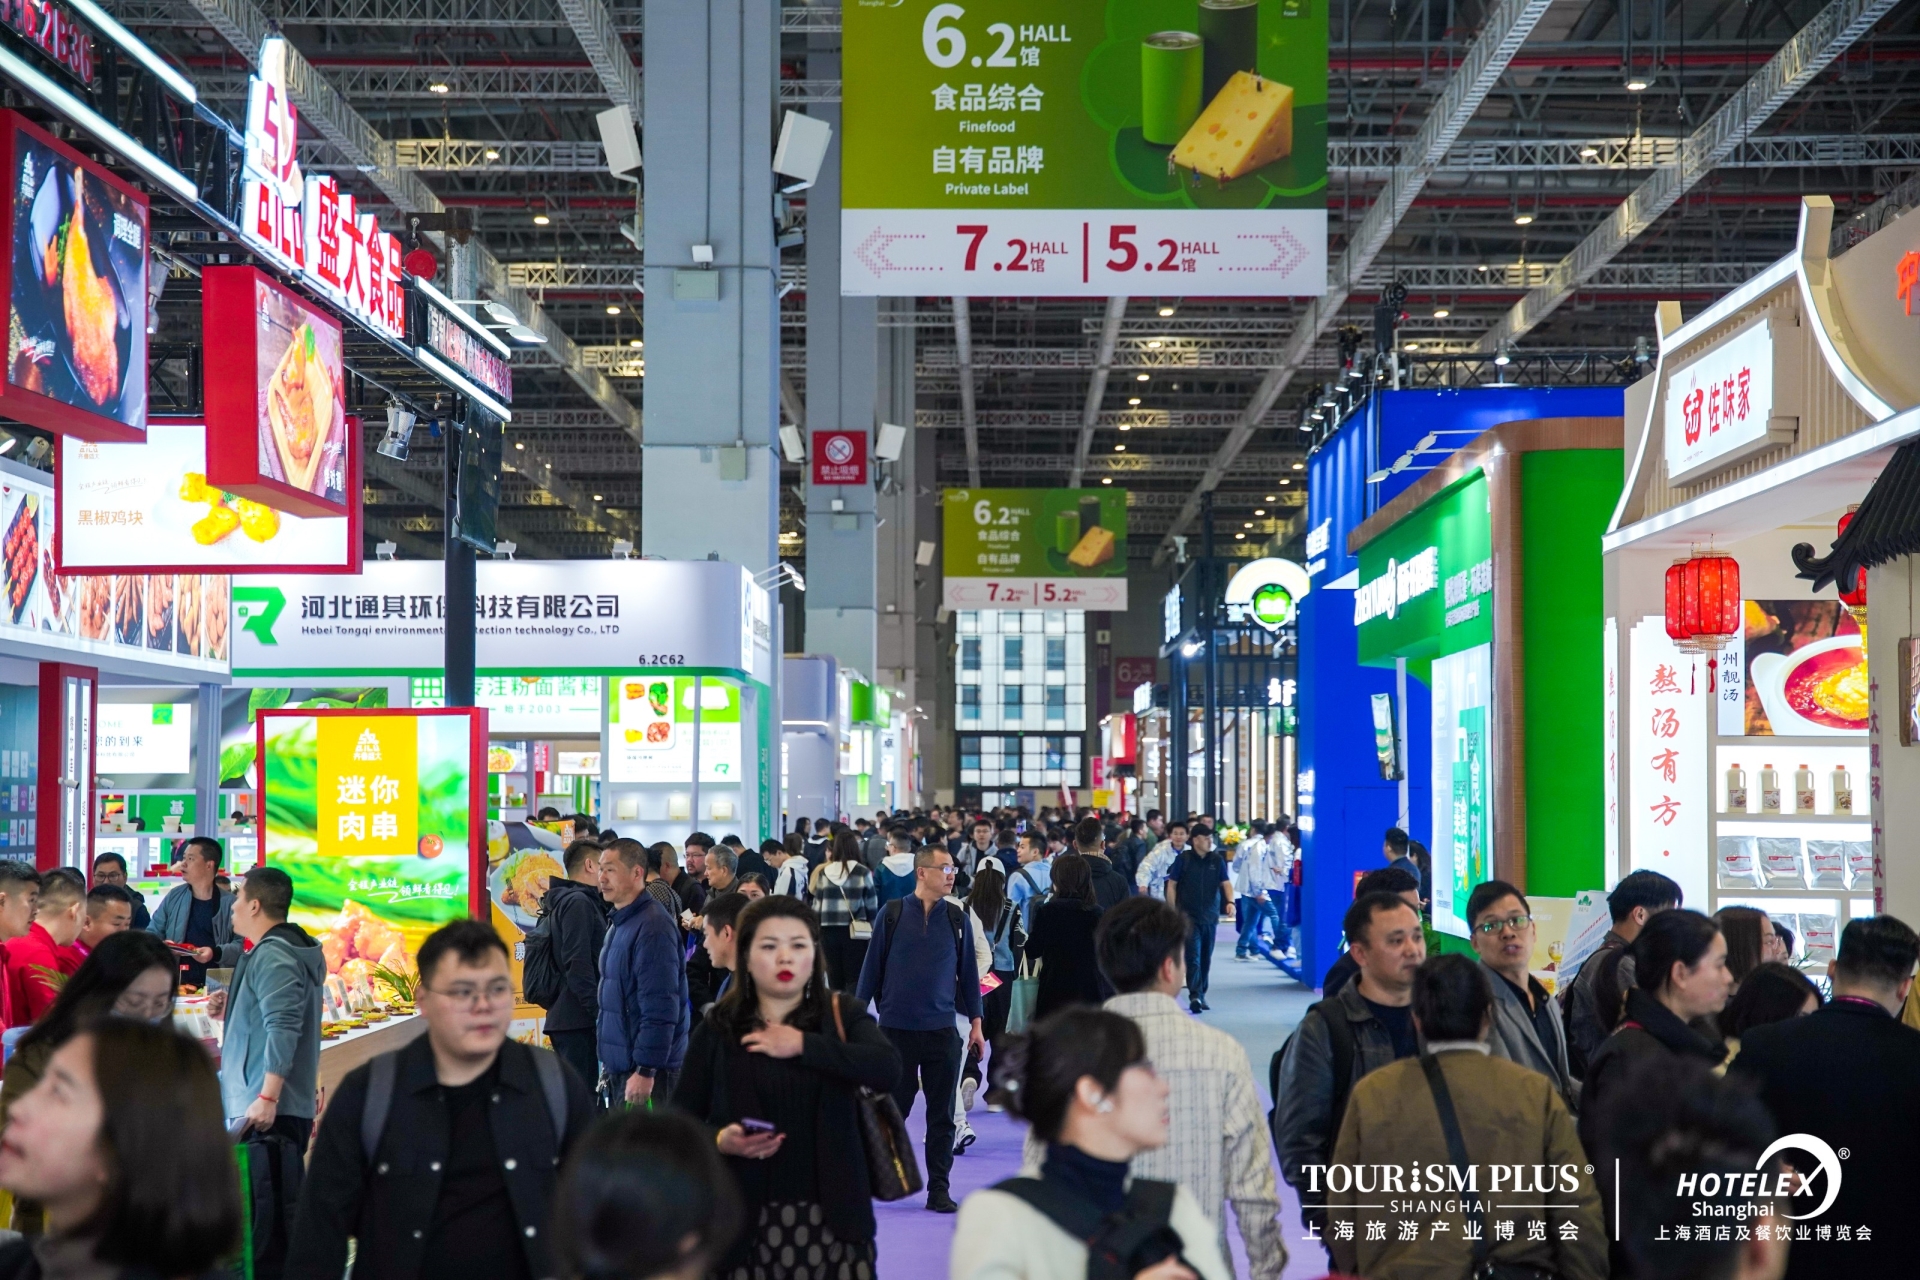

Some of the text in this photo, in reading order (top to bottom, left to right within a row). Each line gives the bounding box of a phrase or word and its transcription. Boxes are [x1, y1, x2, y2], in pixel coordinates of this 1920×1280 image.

[922, 3, 1071, 68] 6.2 HALL 馆
[931, 83, 1044, 112] 食品综合
[959, 120, 1016, 133] Finefood
[932, 146, 1044, 174] 自有品牌
[945, 183, 1029, 196] Private Label
[317, 175, 404, 337] 盛大食品
[956, 225, 1068, 272] 7.2 HALL 馆
[1106, 225, 1220, 272] 5.2 HALL 馆
[1709, 366, 1750, 437] 佐味家
[78, 509, 143, 526] 黑椒鸡块
[974, 500, 1010, 525] 6.2
[977, 529, 1020, 542] 食品综合
[977, 553, 1020, 565] 自有品牌
[987, 583, 1015, 602] 7.2
[1044, 583, 1072, 602] 5.2
[302, 626, 332, 635] Hebei
[336, 626, 372, 637] Tongqi
[515, 625, 574, 637] technology
[577, 625, 597, 636] Co.,
[600, 625, 620, 634] LTD
[638, 655, 685, 667] 6.2C62
[1722, 636, 1740, 702] 州靓汤
[336, 775, 399, 805] 迷你
[338, 811, 398, 841] 肉串
